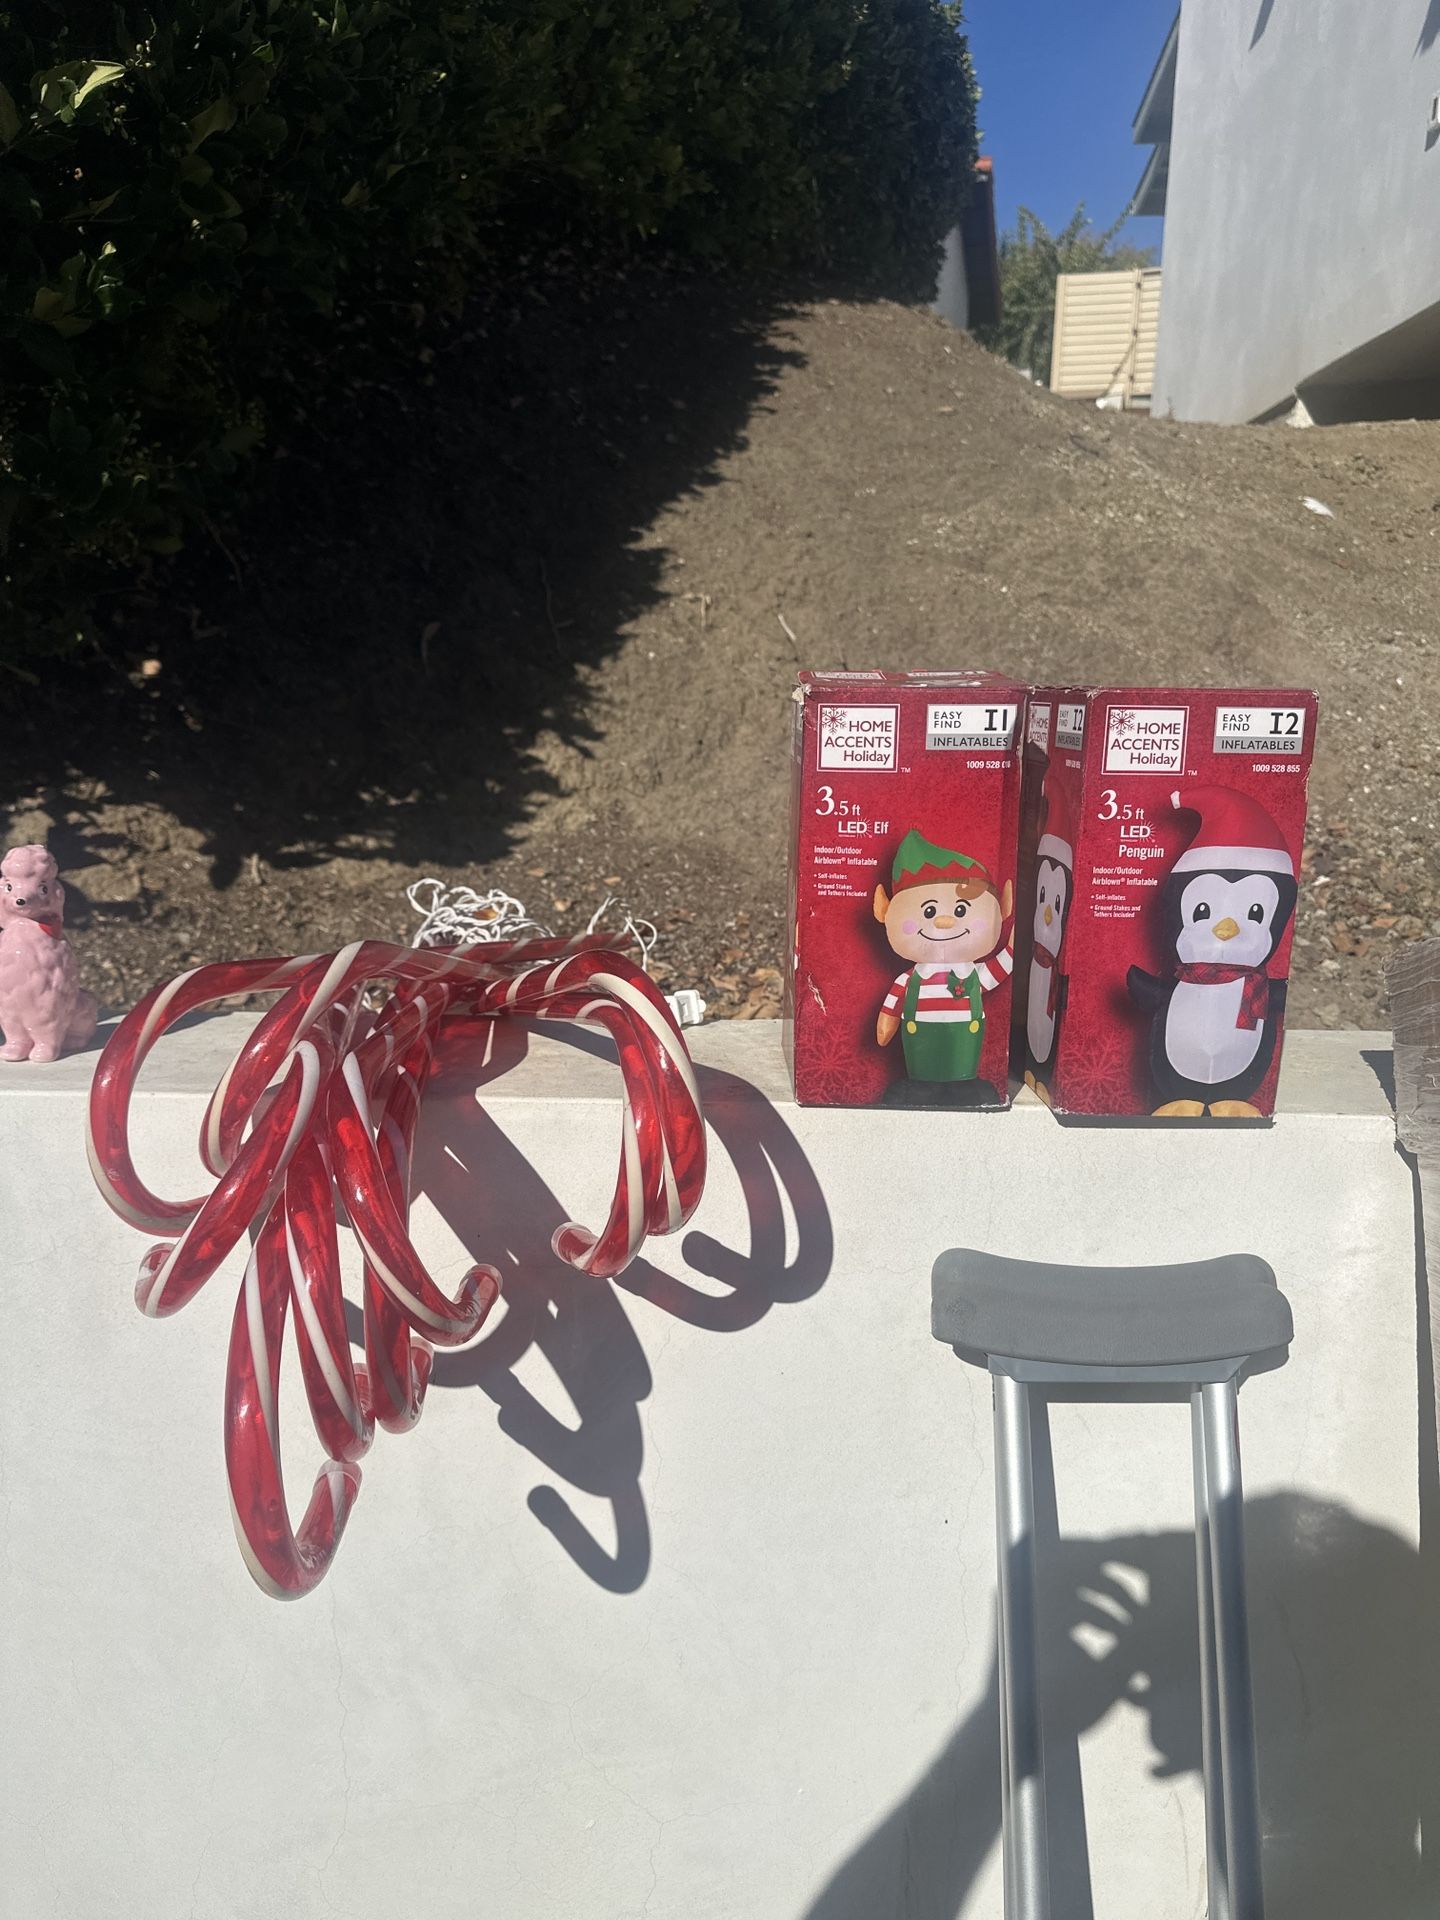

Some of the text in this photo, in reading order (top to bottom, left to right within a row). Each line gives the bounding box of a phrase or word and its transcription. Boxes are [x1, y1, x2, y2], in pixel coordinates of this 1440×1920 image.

[934, 712, 962, 720] EASY
[1072, 709, 1083, 731] I2
[1222, 714, 1252, 722] EASY
[849, 720, 892, 732] HOME
[1136, 722, 1181, 735] HOME
[1270, 712, 1298, 734] I2
[824, 736, 892, 748] ACCENTS
[934, 737, 1008, 746] INFLATABLES
[1110, 738, 1180, 750] ACCENTS
[1221, 740, 1296, 750] INFLATABLES
[844, 750, 890, 766] Holiday
[966, 760, 984, 768] 1009
[986, 760, 1000, 768] 528
[1130, 752, 1178, 768] Holiday
[1252, 764, 1300, 772] 1009 528 855
[816, 786, 860, 816] 3.5 ft
[1098, 790, 1144, 820] 3.5 ft
[838, 820, 889, 834] LED Elf
[1120, 826, 1150, 838] LED
[814, 846, 862, 854] Indoor/Outdoor
[1118, 844, 1164, 860] Penguin
[848, 858, 878, 866] Inflatable
[1092, 866, 1142, 875] Indoor/Outdoor
[1126, 878, 1158, 886] Inflatable
